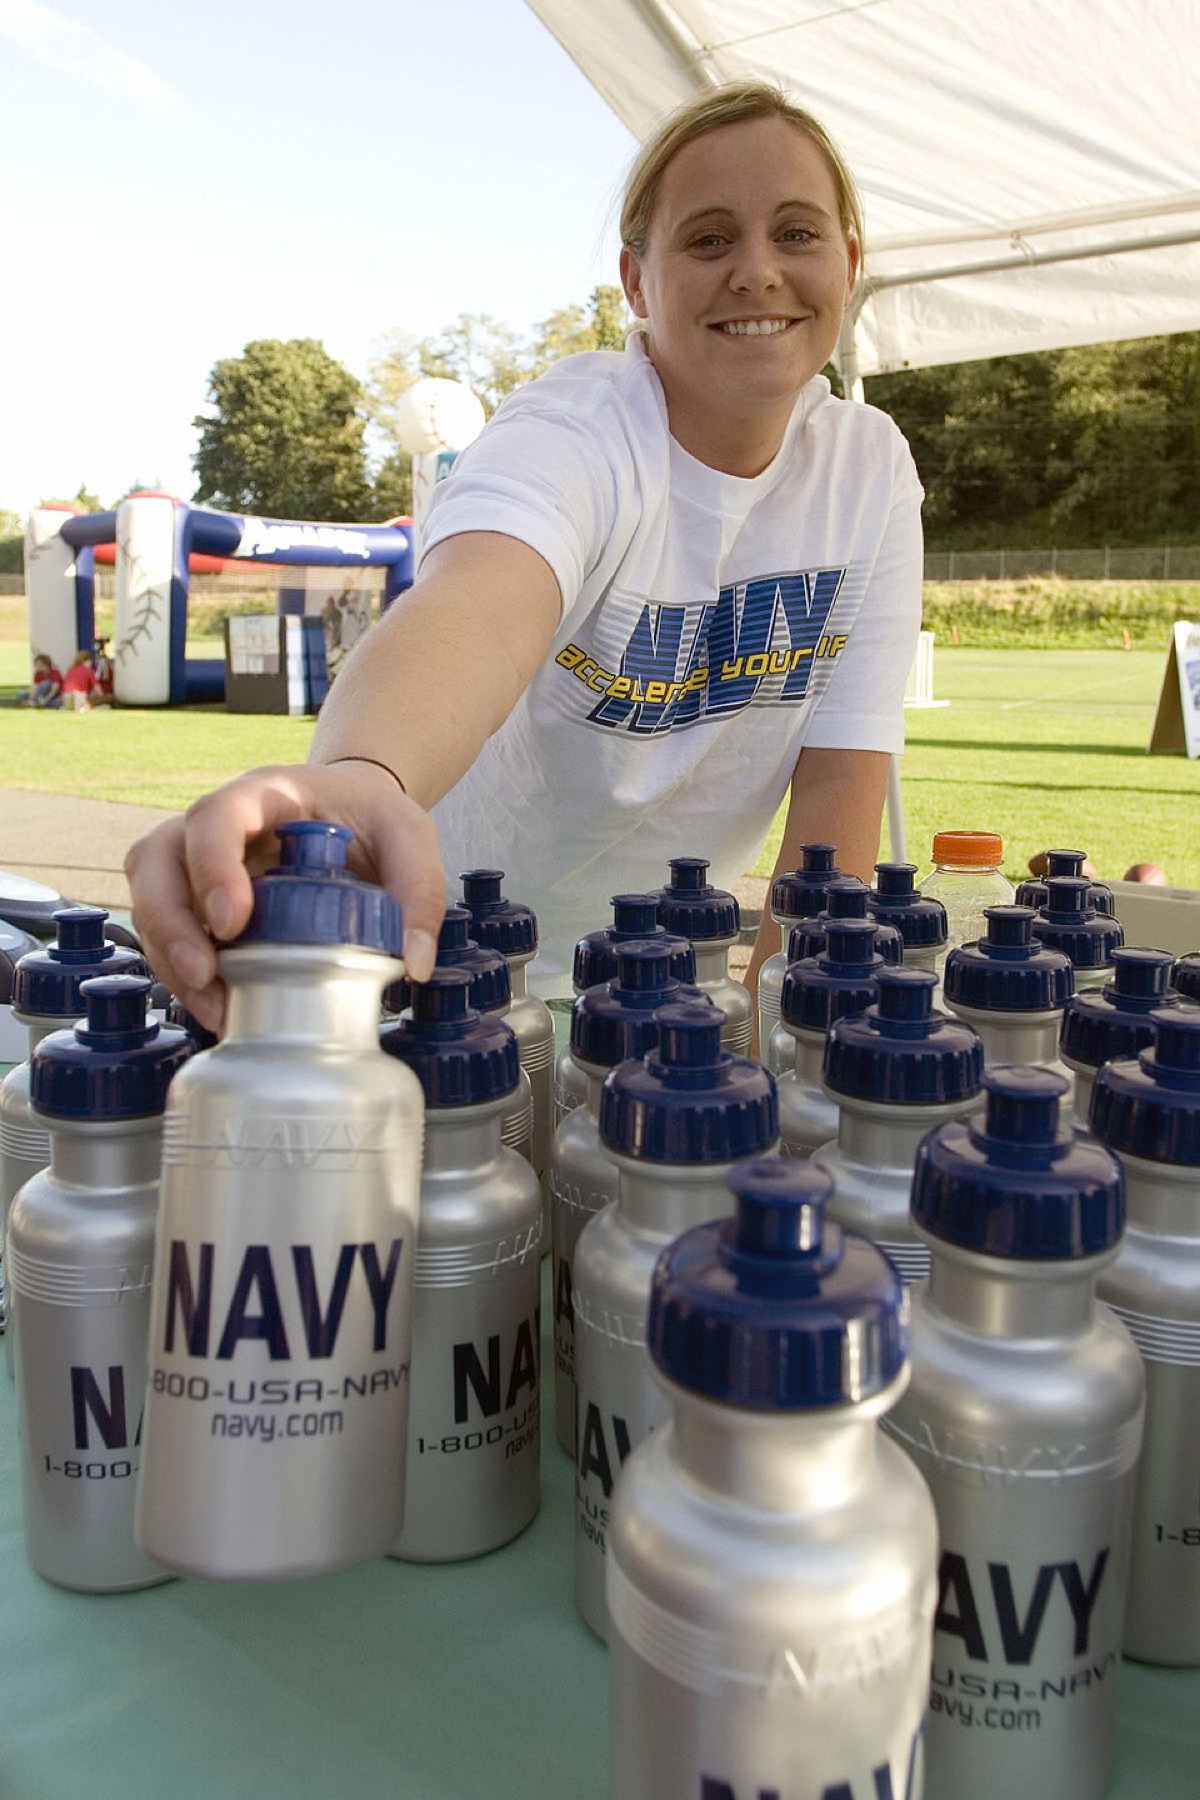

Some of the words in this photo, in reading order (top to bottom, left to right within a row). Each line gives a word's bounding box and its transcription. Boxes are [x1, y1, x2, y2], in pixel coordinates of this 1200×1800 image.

[719, 647, 814, 681] your
[164, 1238, 404, 1361] NAVY
[152, 1359, 411, 1405] 800-USA-NAVY
[211, 1410, 344, 1442] navy.com
[934, 1546, 1111, 1666] AVY
[929, 1691, 1041, 1731] avy.com
